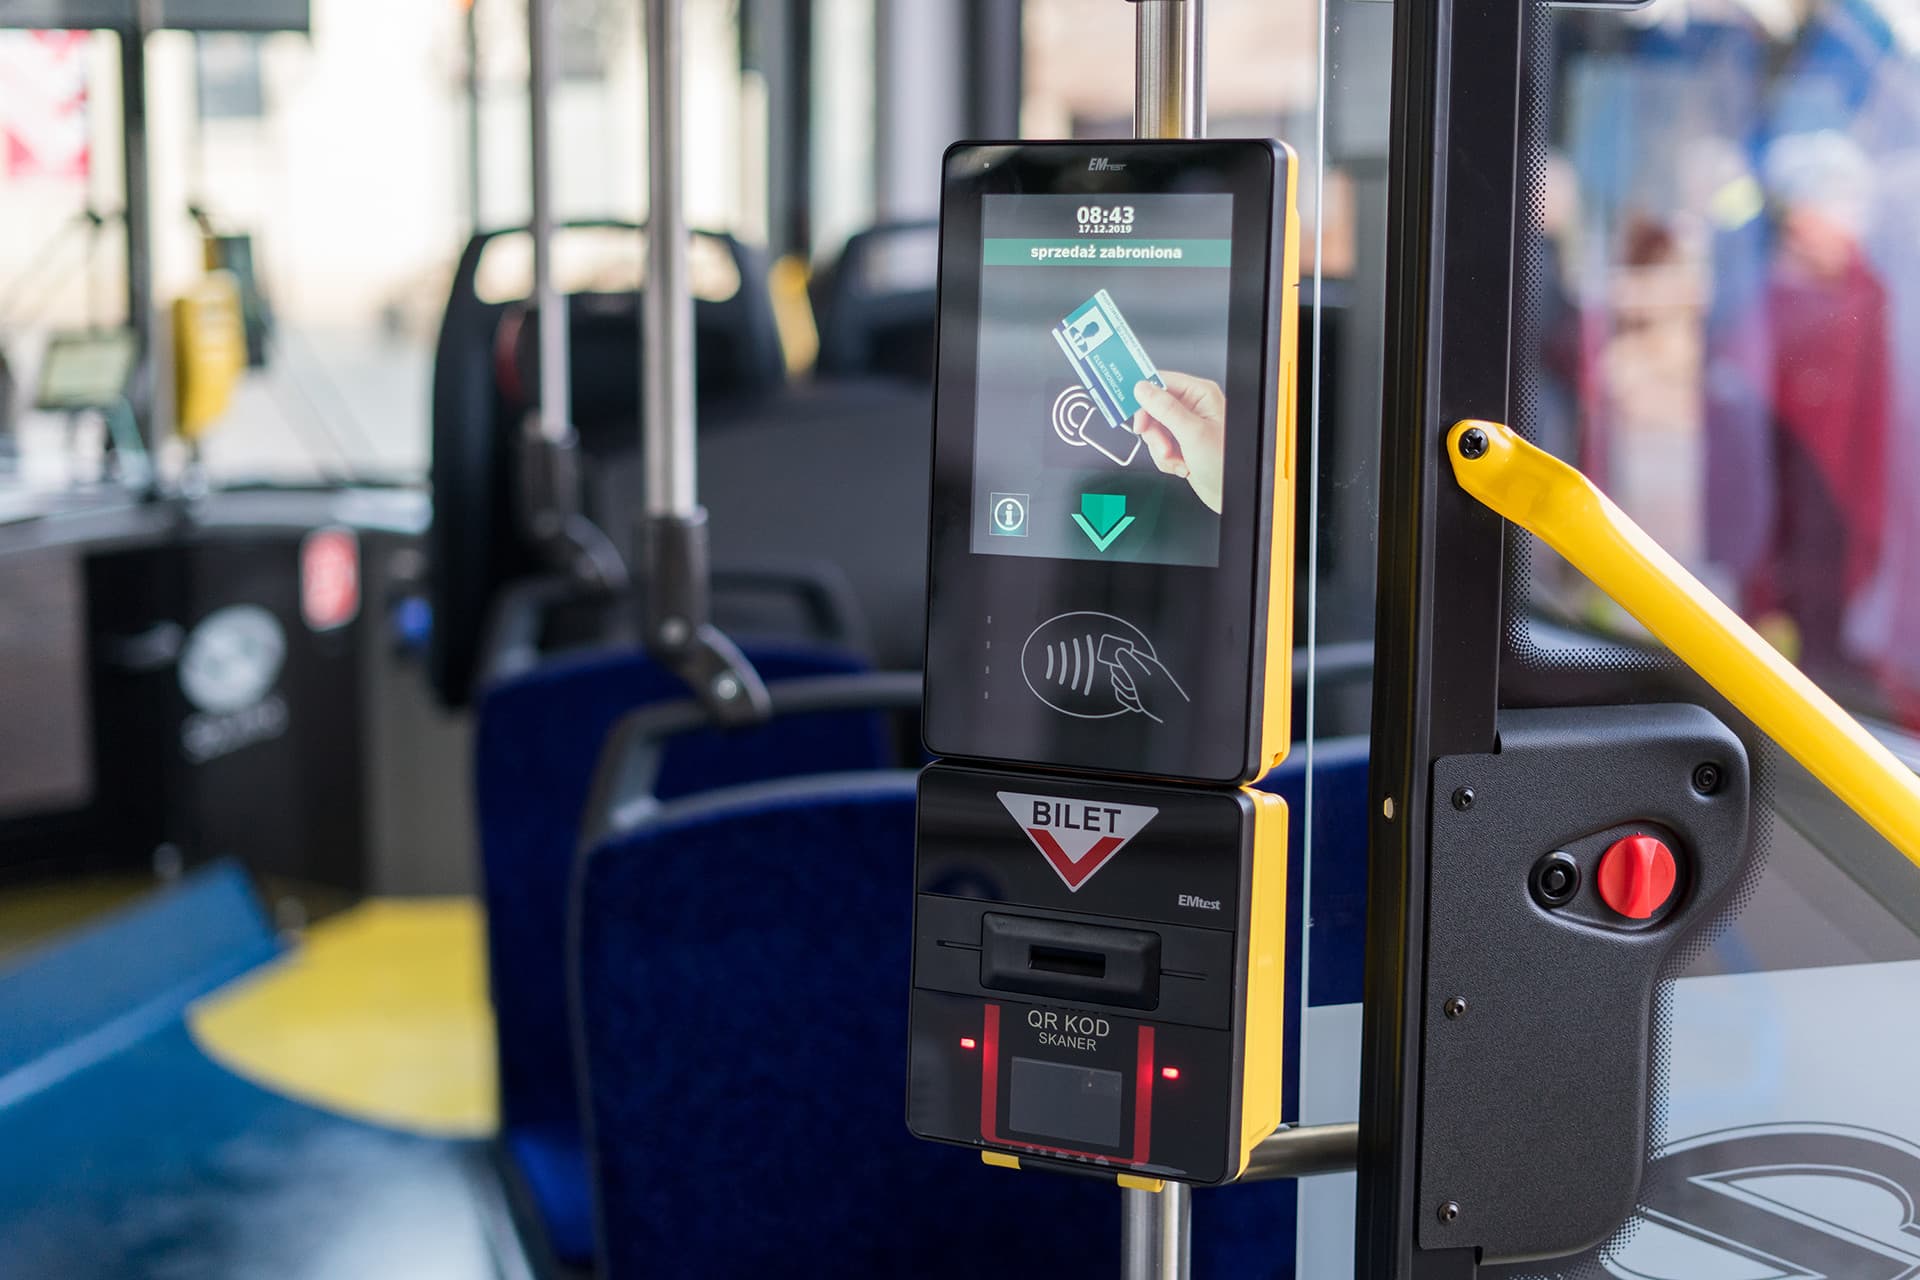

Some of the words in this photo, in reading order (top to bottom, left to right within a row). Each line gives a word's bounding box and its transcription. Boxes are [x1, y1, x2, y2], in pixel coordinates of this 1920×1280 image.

[1077, 206, 1134, 224] 08:43
[1079, 224, 1132, 234] 17.12.2019
[1031, 245, 1096, 260] sprzedaż
[1100, 246, 1182, 259] zabroniona
[1033, 801, 1121, 833] BILET
[1178, 894, 1221, 911] EMtest
[1028, 1010, 1058, 1031] QR
[1065, 1015, 1110, 1037] KOD
[1039, 1032, 1097, 1051] SKANER
